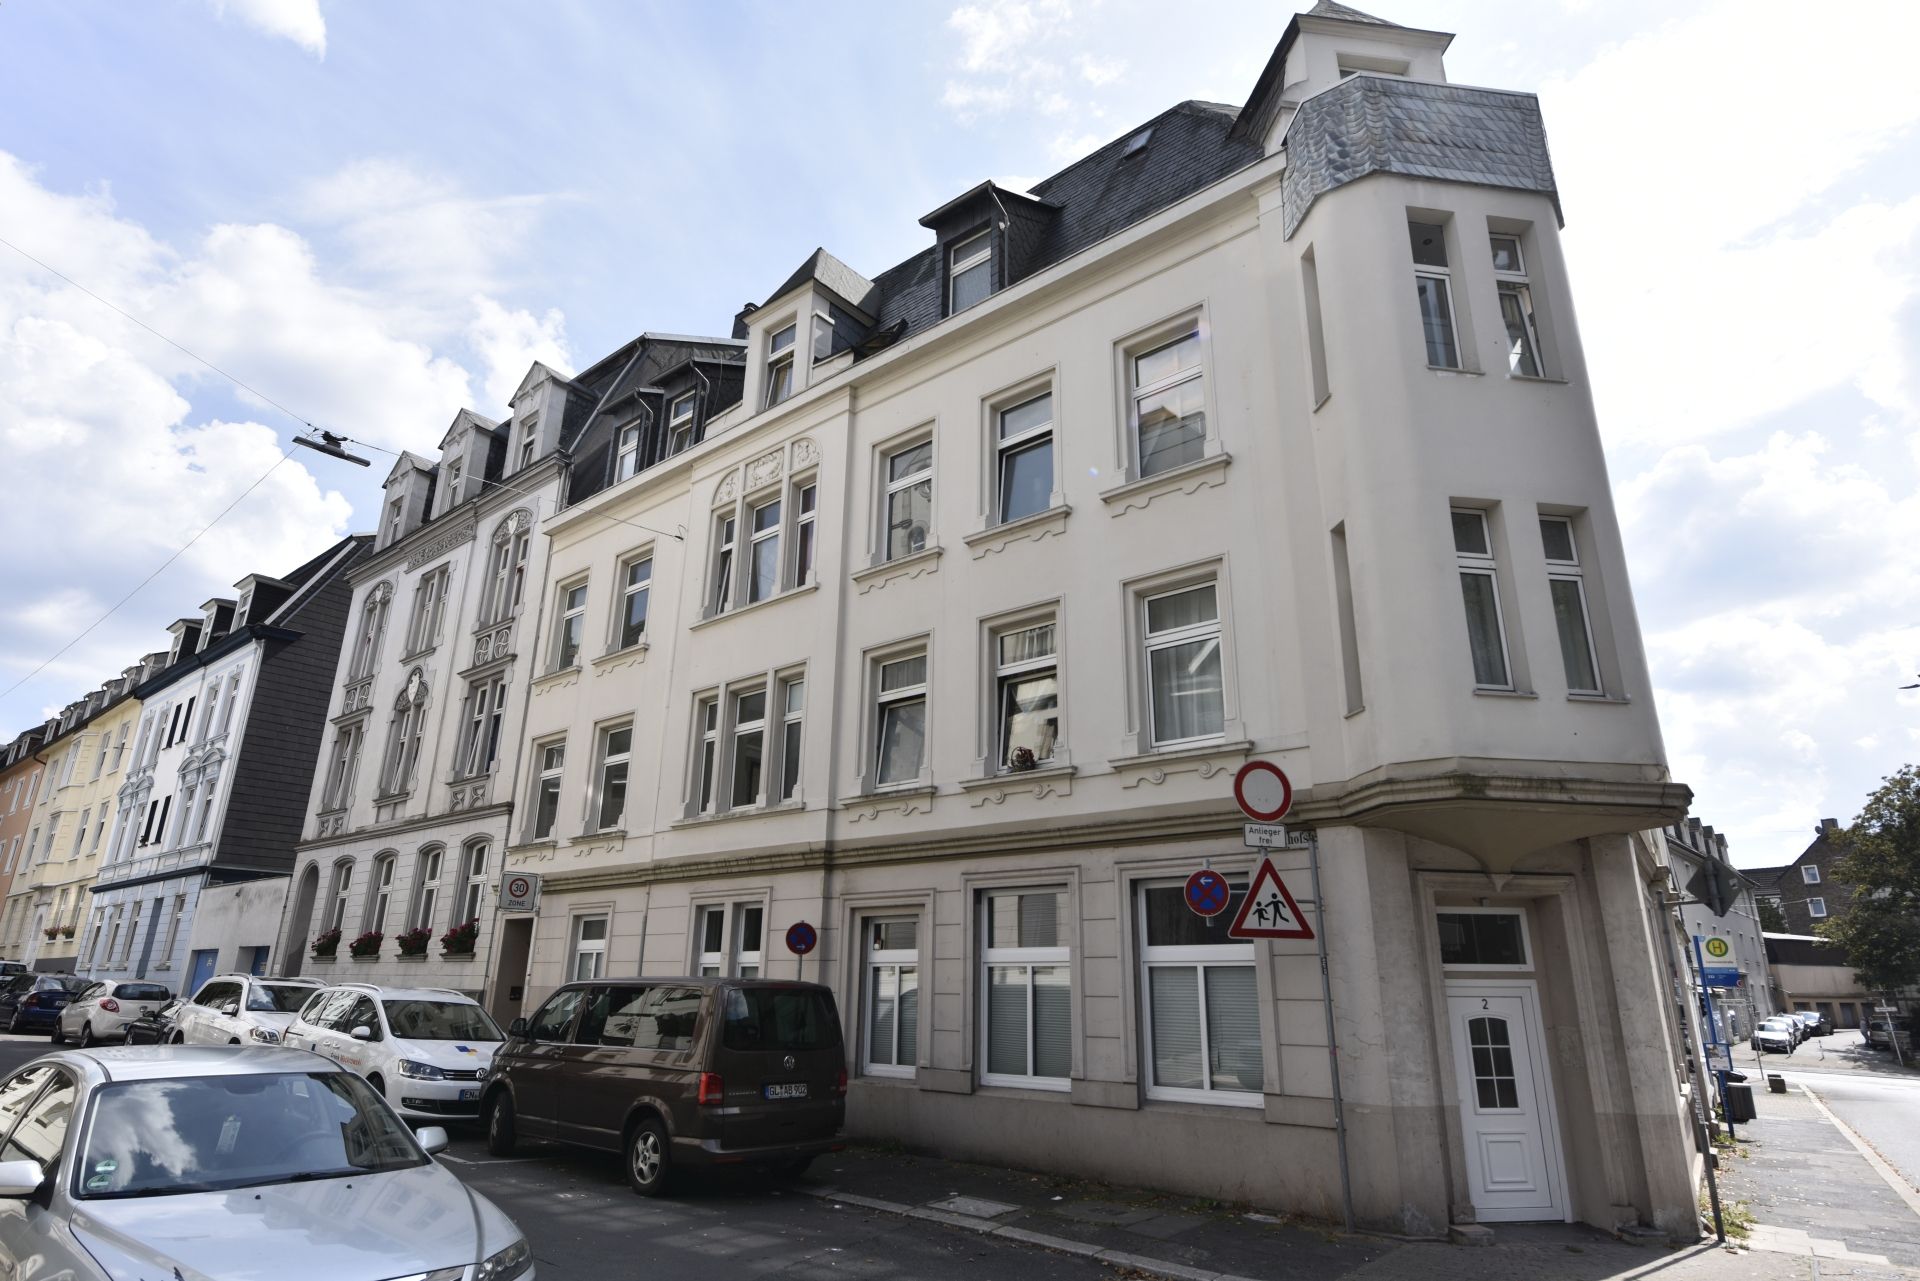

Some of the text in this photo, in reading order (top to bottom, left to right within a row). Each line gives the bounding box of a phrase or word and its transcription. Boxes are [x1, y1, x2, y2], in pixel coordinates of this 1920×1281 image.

[1248, 826, 1281, 836] Anlieger
[1259, 836, 1273, 845] frei
[513, 883, 525, 892] 30
[1481, 998, 1489, 1010] 2
